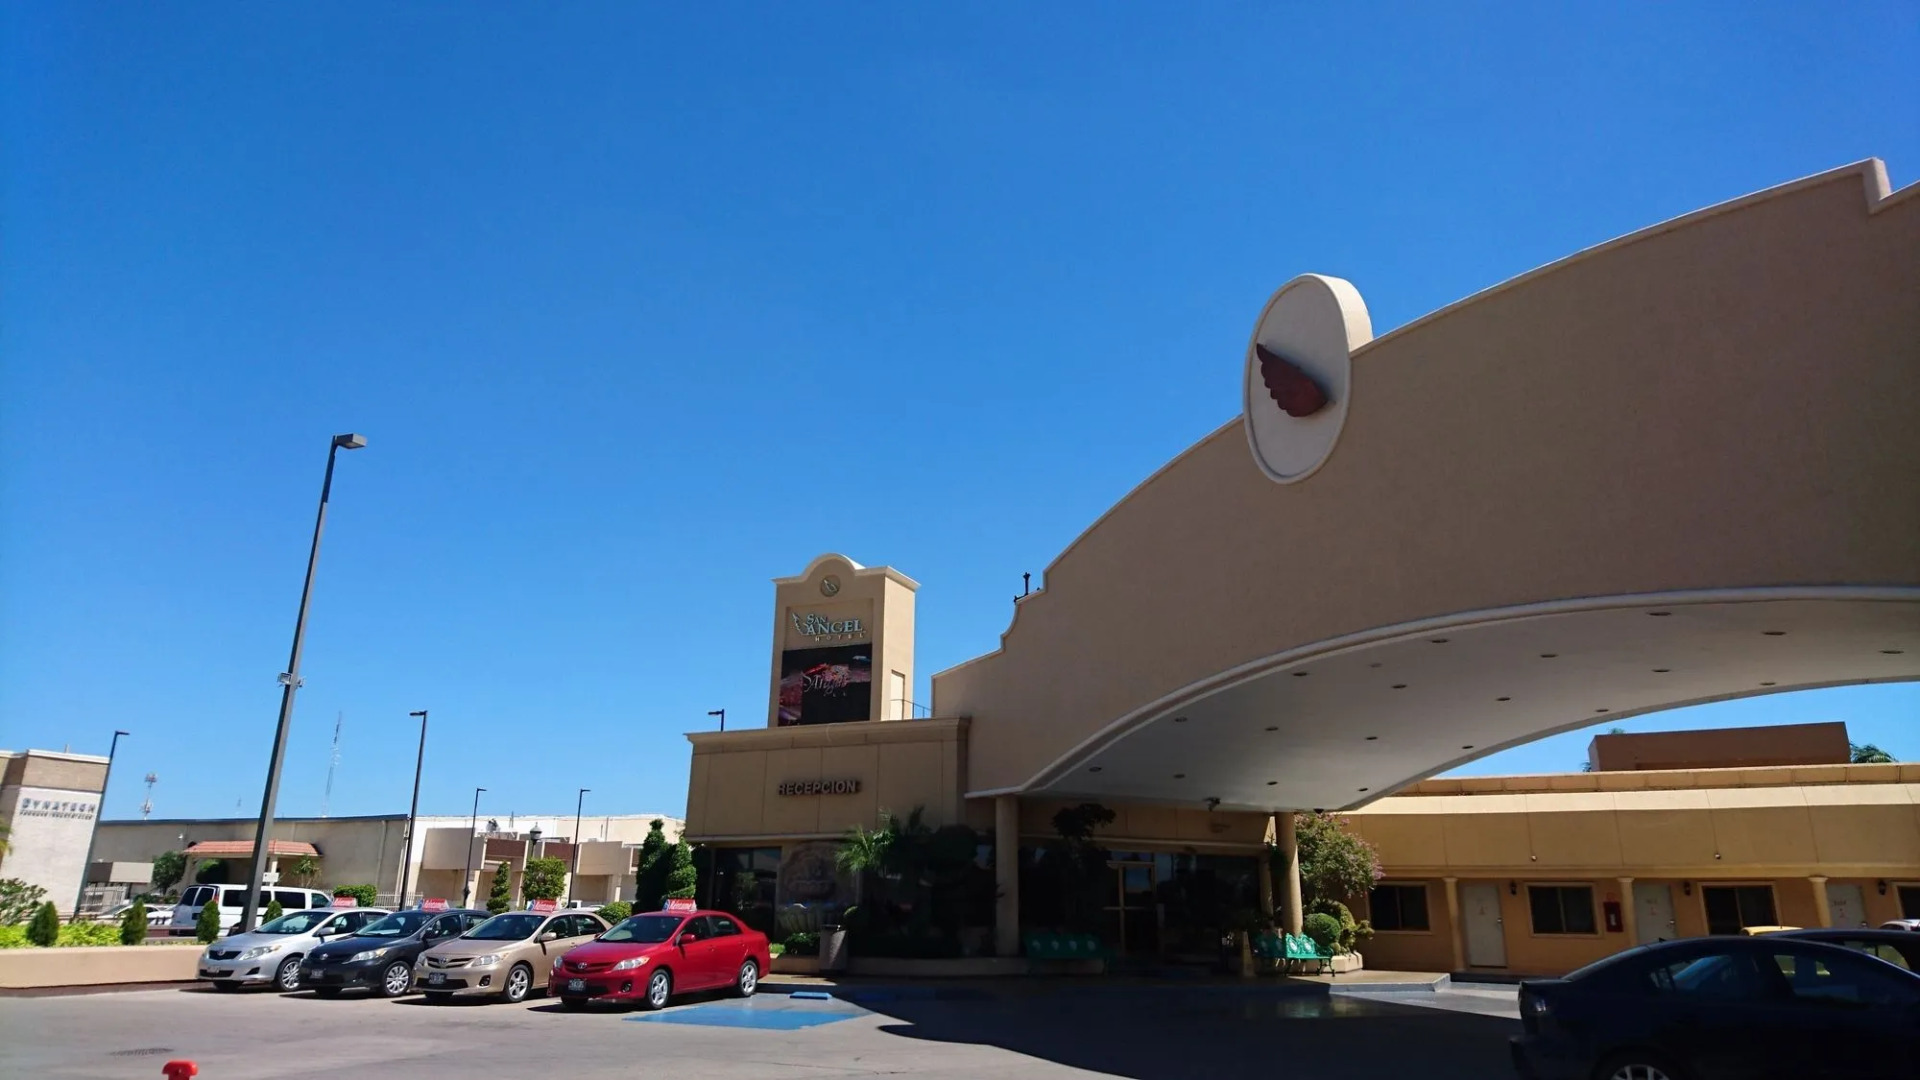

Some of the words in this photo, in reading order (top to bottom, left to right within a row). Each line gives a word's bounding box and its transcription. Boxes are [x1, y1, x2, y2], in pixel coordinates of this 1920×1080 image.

[806, 613, 828, 623] SAN
[804, 619, 862, 635] ANGEL
[816, 632, 863, 642] HOTEL
[778, 780, 858, 795] RECEPCION
